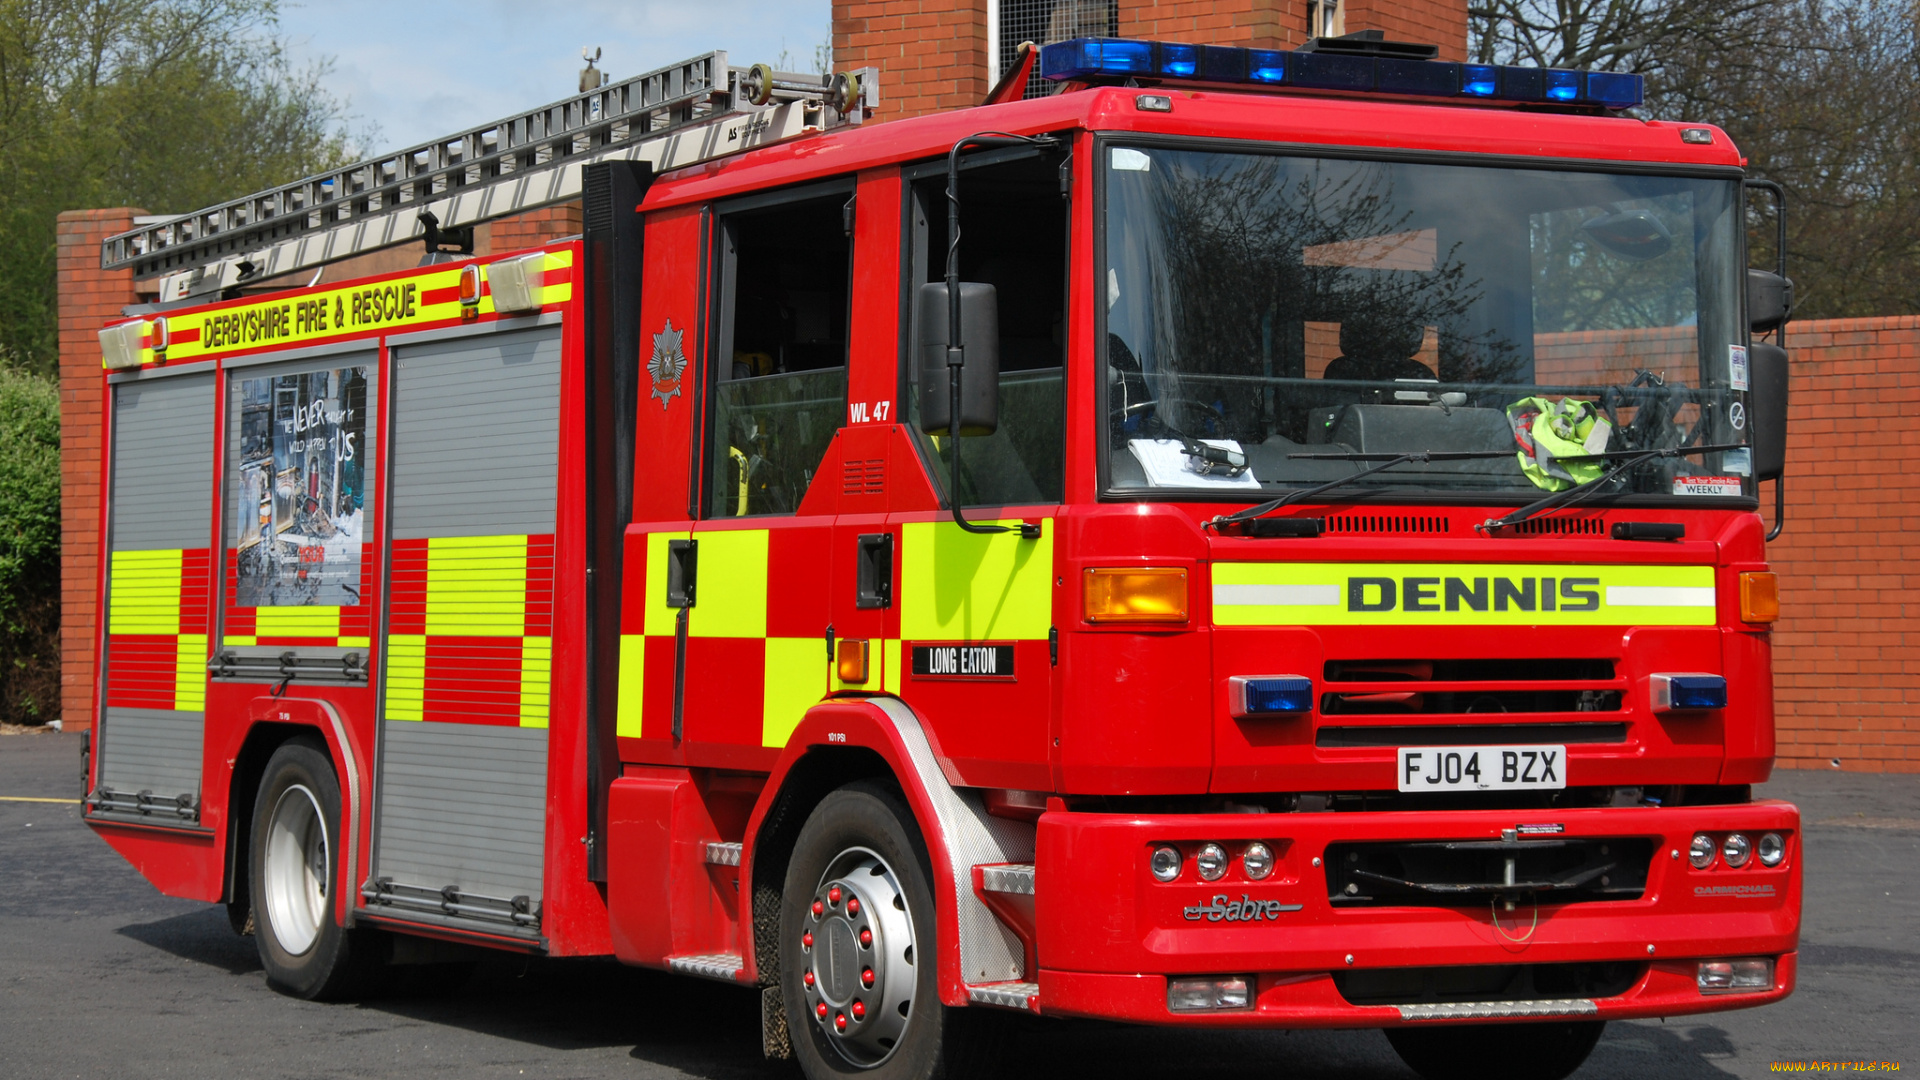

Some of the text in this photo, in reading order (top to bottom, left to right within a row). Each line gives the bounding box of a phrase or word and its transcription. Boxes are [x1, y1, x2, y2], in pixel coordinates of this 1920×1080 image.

[728, 127, 738, 143] AS
[204, 282, 417, 349] DERBYSHIRE FIRE & RESCUE
[293, 399, 326, 435] NEVER
[850, 400, 890, 424] WL 47
[336, 427, 356, 462] US
[1686, 485, 1723, 495] WEEKLY
[1709, 477, 1726, 485] Smoke
[298, 545, 325, 563] YOUR
[1347, 576, 1600, 612] DENNIS
[929, 647, 996, 674] LONG EATON
[837, 732, 847, 743] PSI
[1405, 751, 1557, 785] FJ04 BZX
[1694, 884, 1776, 895] CARMICHAEL
[1207, 894, 1280, 921] Sabre
